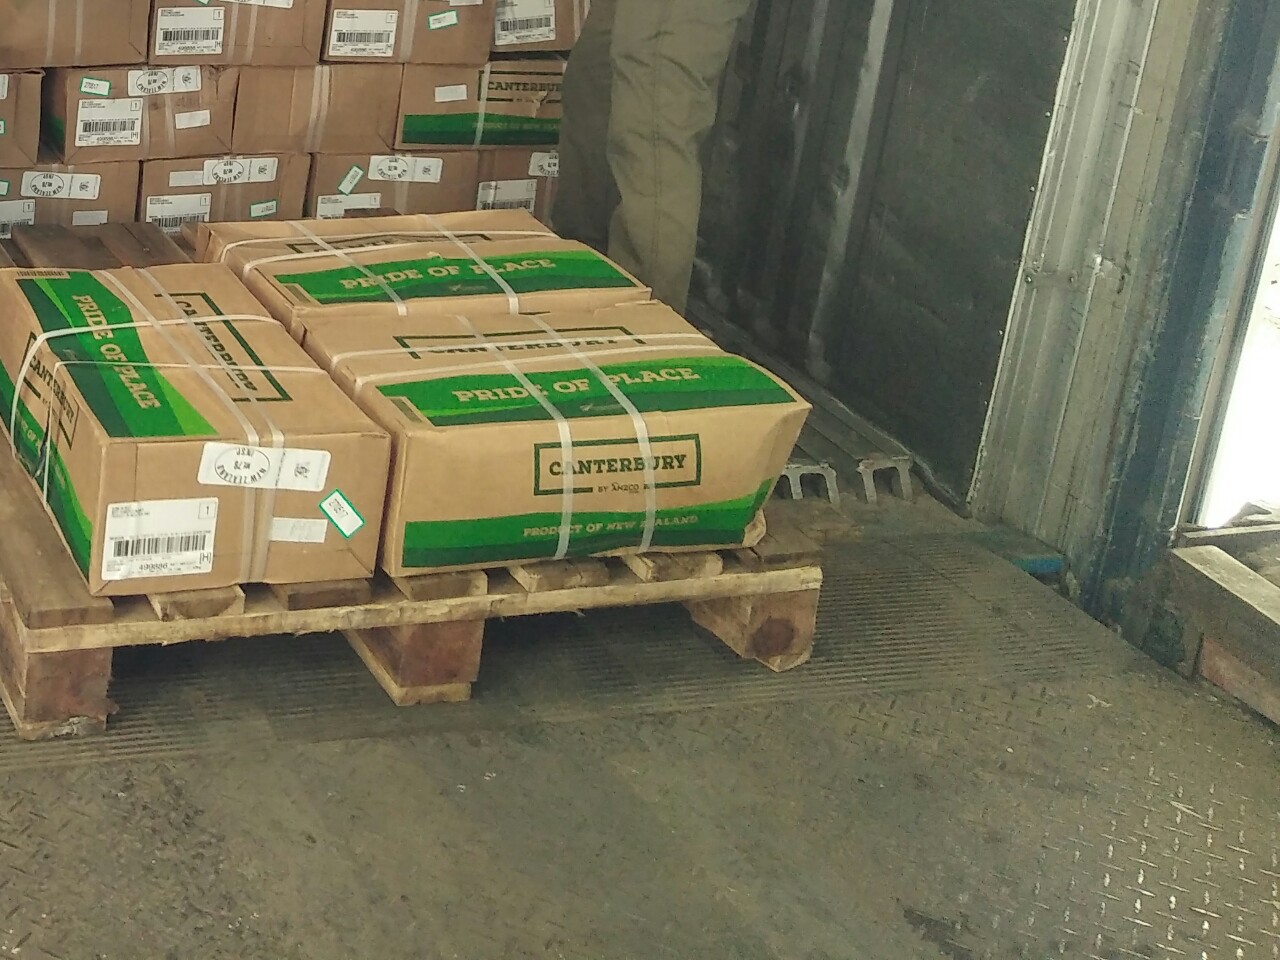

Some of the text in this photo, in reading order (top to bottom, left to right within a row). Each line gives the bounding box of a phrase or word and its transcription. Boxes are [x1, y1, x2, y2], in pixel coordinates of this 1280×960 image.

[340, 258, 557, 289] PRIDE OF PLACE
[71, 294, 161, 409] PRIDE OF PLACE
[452, 367, 701, 403] PRIDE OF PLACE
[549, 453, 688, 477] CANTERBURY
[586, 521, 605, 533] OF
